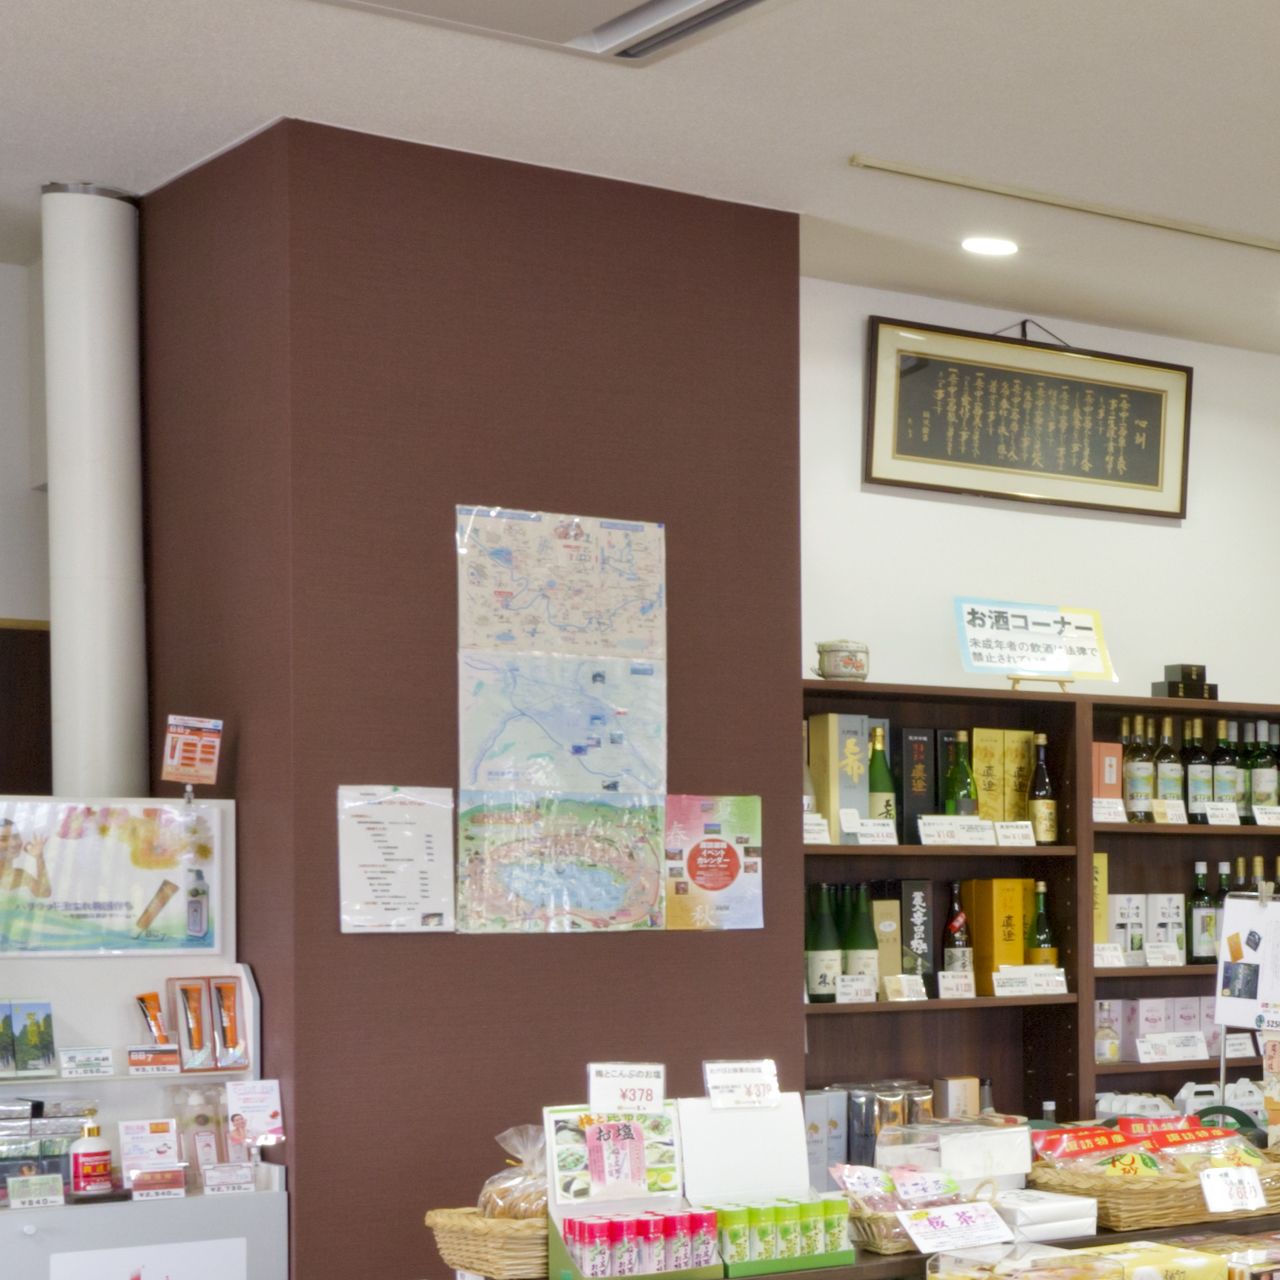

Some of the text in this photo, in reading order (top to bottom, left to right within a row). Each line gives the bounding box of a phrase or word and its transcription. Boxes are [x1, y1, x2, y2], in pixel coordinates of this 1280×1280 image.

[966, 607, 1094, 636] お酒コーナー
[619, 1087, 654, 1102] ¥378
[595, 1124, 636, 1141] お塩
